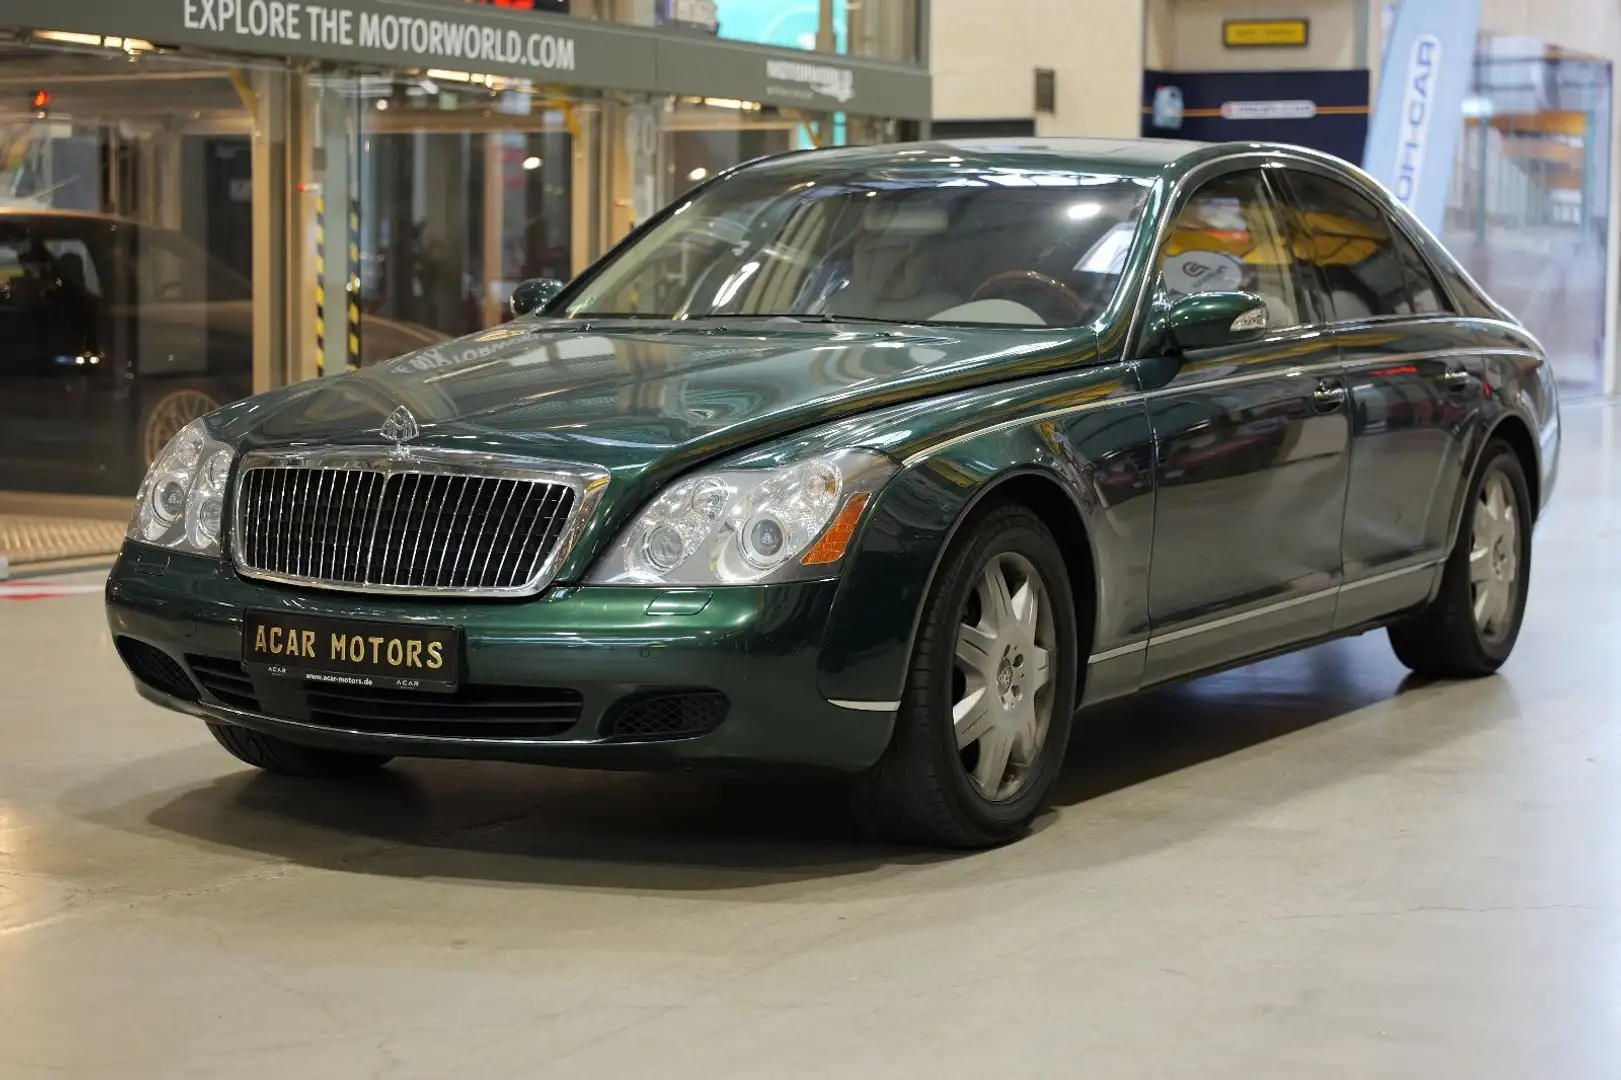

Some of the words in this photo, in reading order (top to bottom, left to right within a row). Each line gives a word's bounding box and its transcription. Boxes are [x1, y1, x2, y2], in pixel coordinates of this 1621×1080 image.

[184, 0, 301, 39] EXPLORE
[305, 5, 354, 46] THE
[359, 12, 575, 70] MOTORWORLD.COM
[255, 625, 316, 657] ACAR
[331, 633, 443, 668] MOTORS
[268, 665, 287, 674] ACAR
[305, 673, 373, 685] www.acar-motors.de
